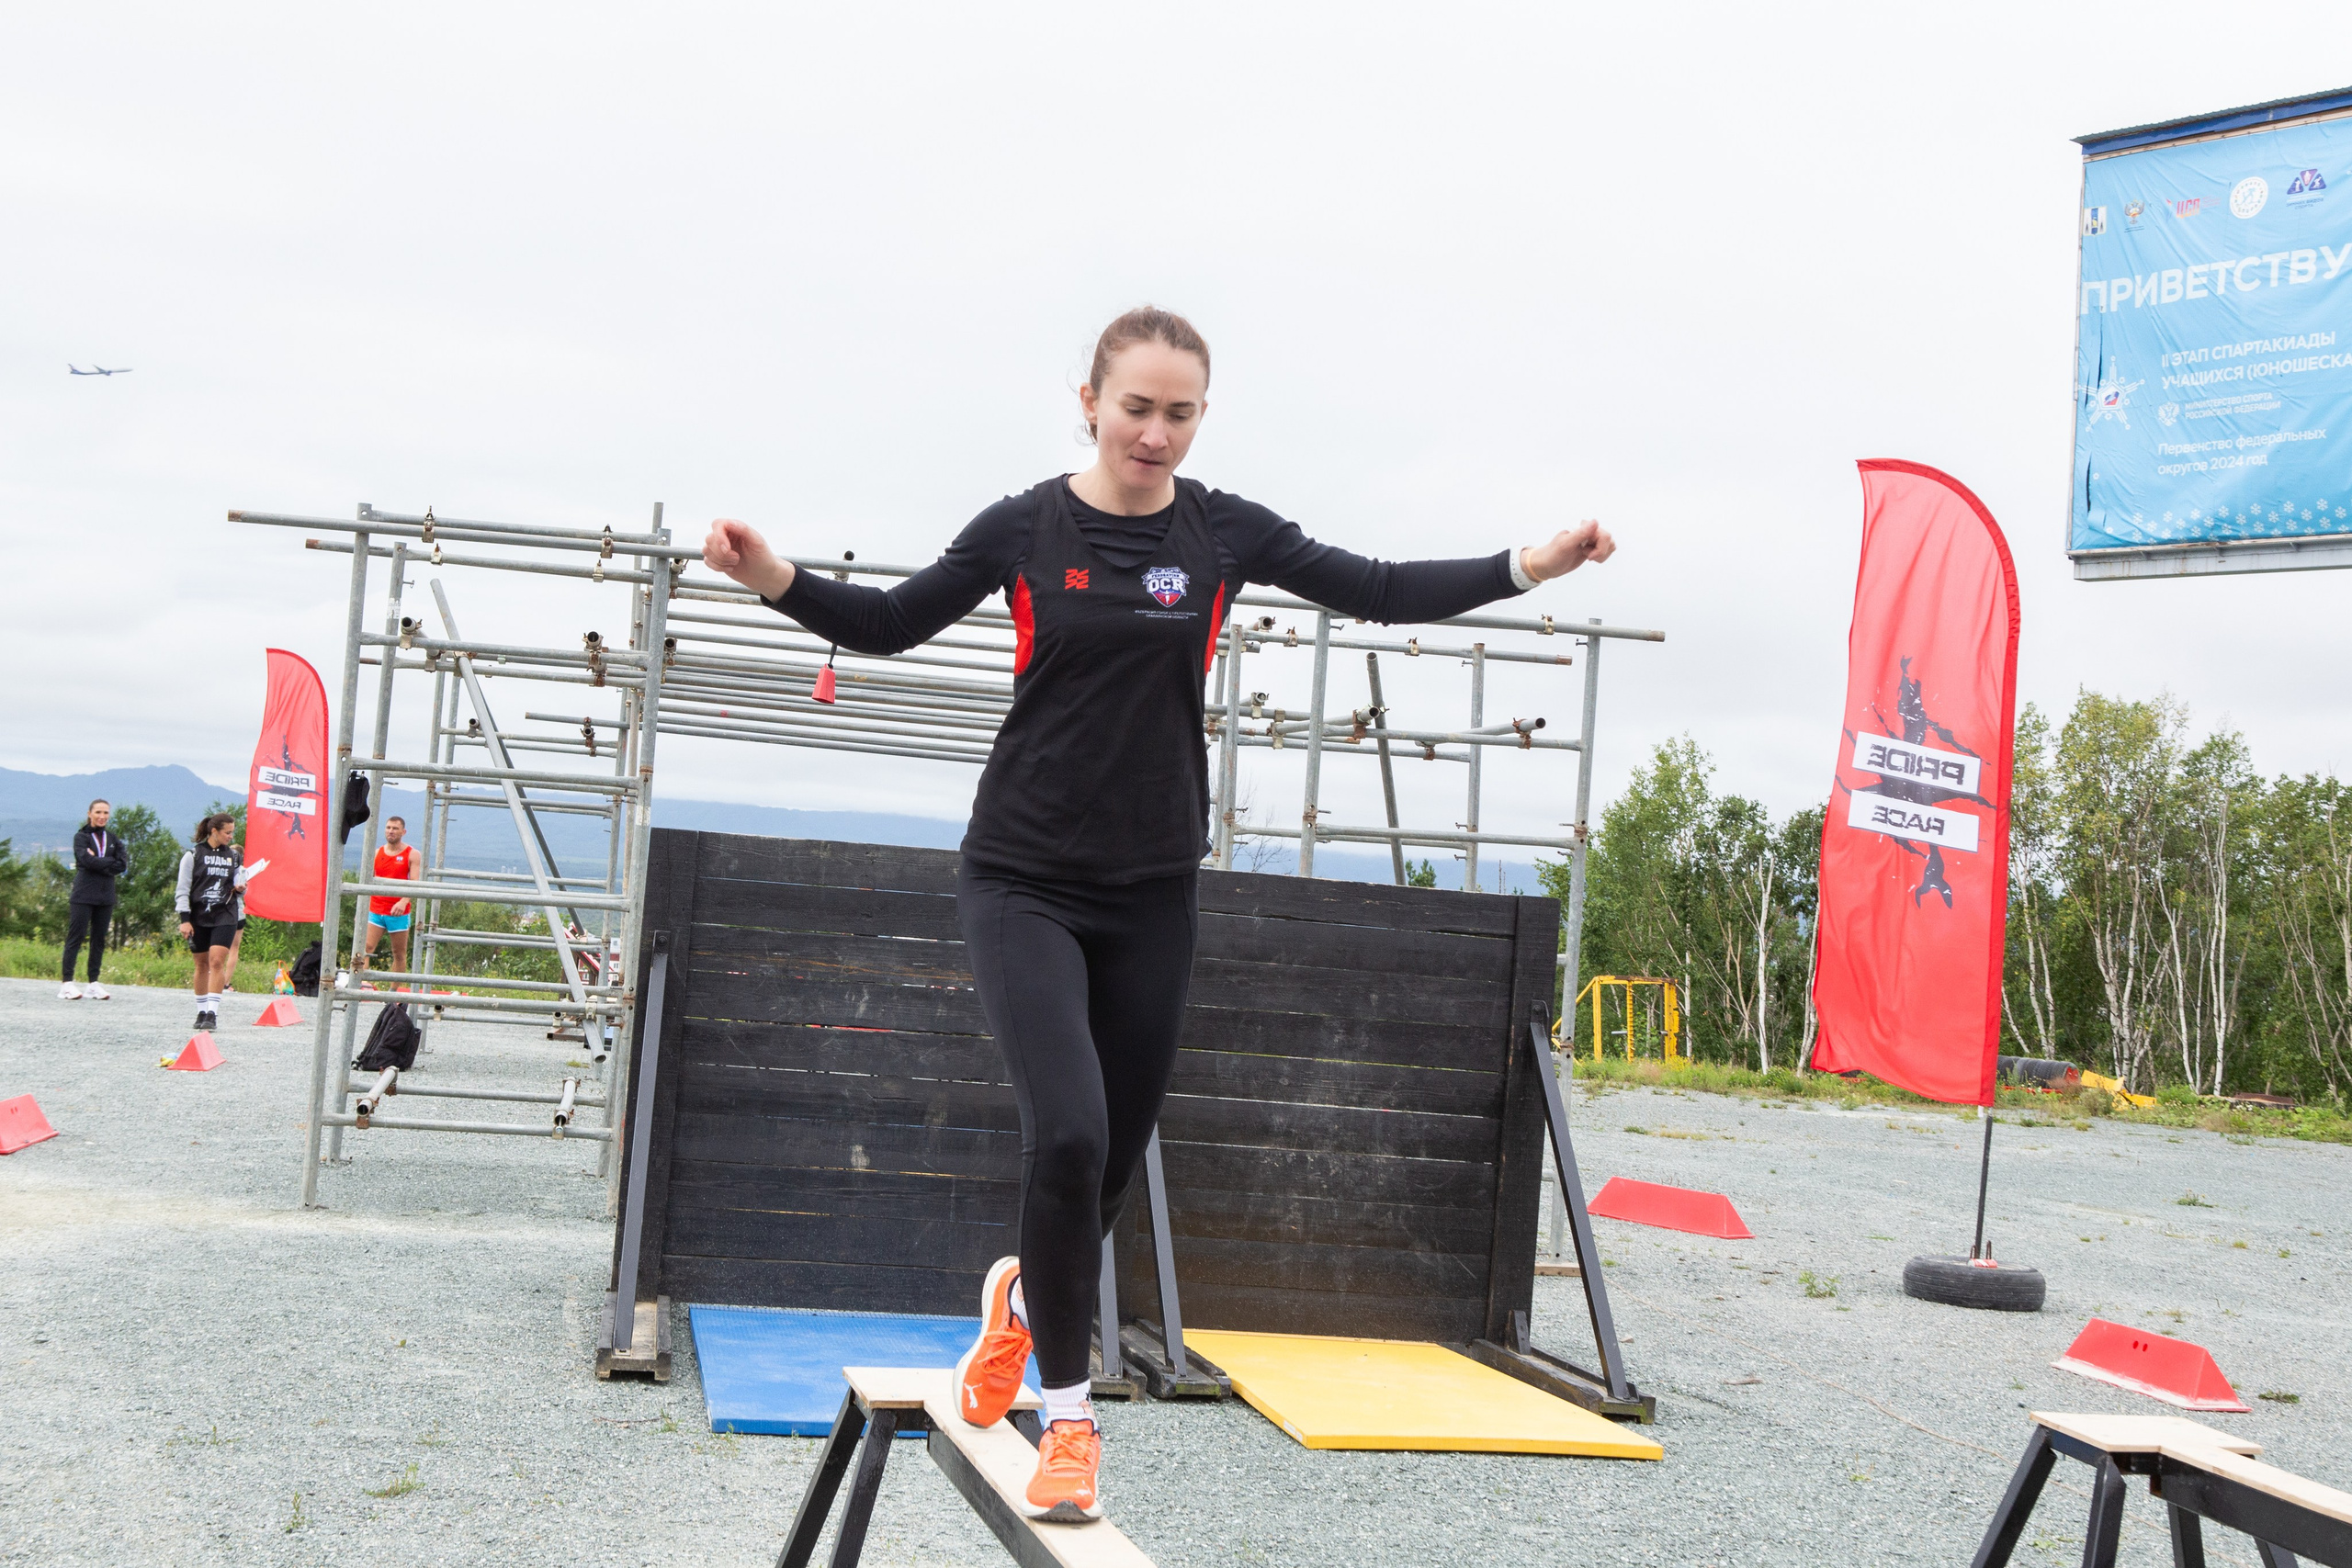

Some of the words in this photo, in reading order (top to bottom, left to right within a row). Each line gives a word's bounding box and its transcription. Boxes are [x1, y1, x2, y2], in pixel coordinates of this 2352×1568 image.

[2171, 347, 2209, 367] ЭТАП
[2211, 331, 2336, 360] СПАРТАКИАДЫ
[2161, 366, 2244, 389] УЧАЩИХСЯ
[2243, 392, 2273, 404] СПОРТА
[2159, 438, 2233, 457] Первенство
[2235, 428, 2327, 450] федеральных
[2158, 460, 2208, 476] округов
[2211, 455, 2244, 470] 2024
[2245, 454, 2267, 467] год
[1148, 578, 1185, 593] OCR
[204, 855, 232, 866] СУДЬЯ
[207, 866, 229, 876] JUDGE
